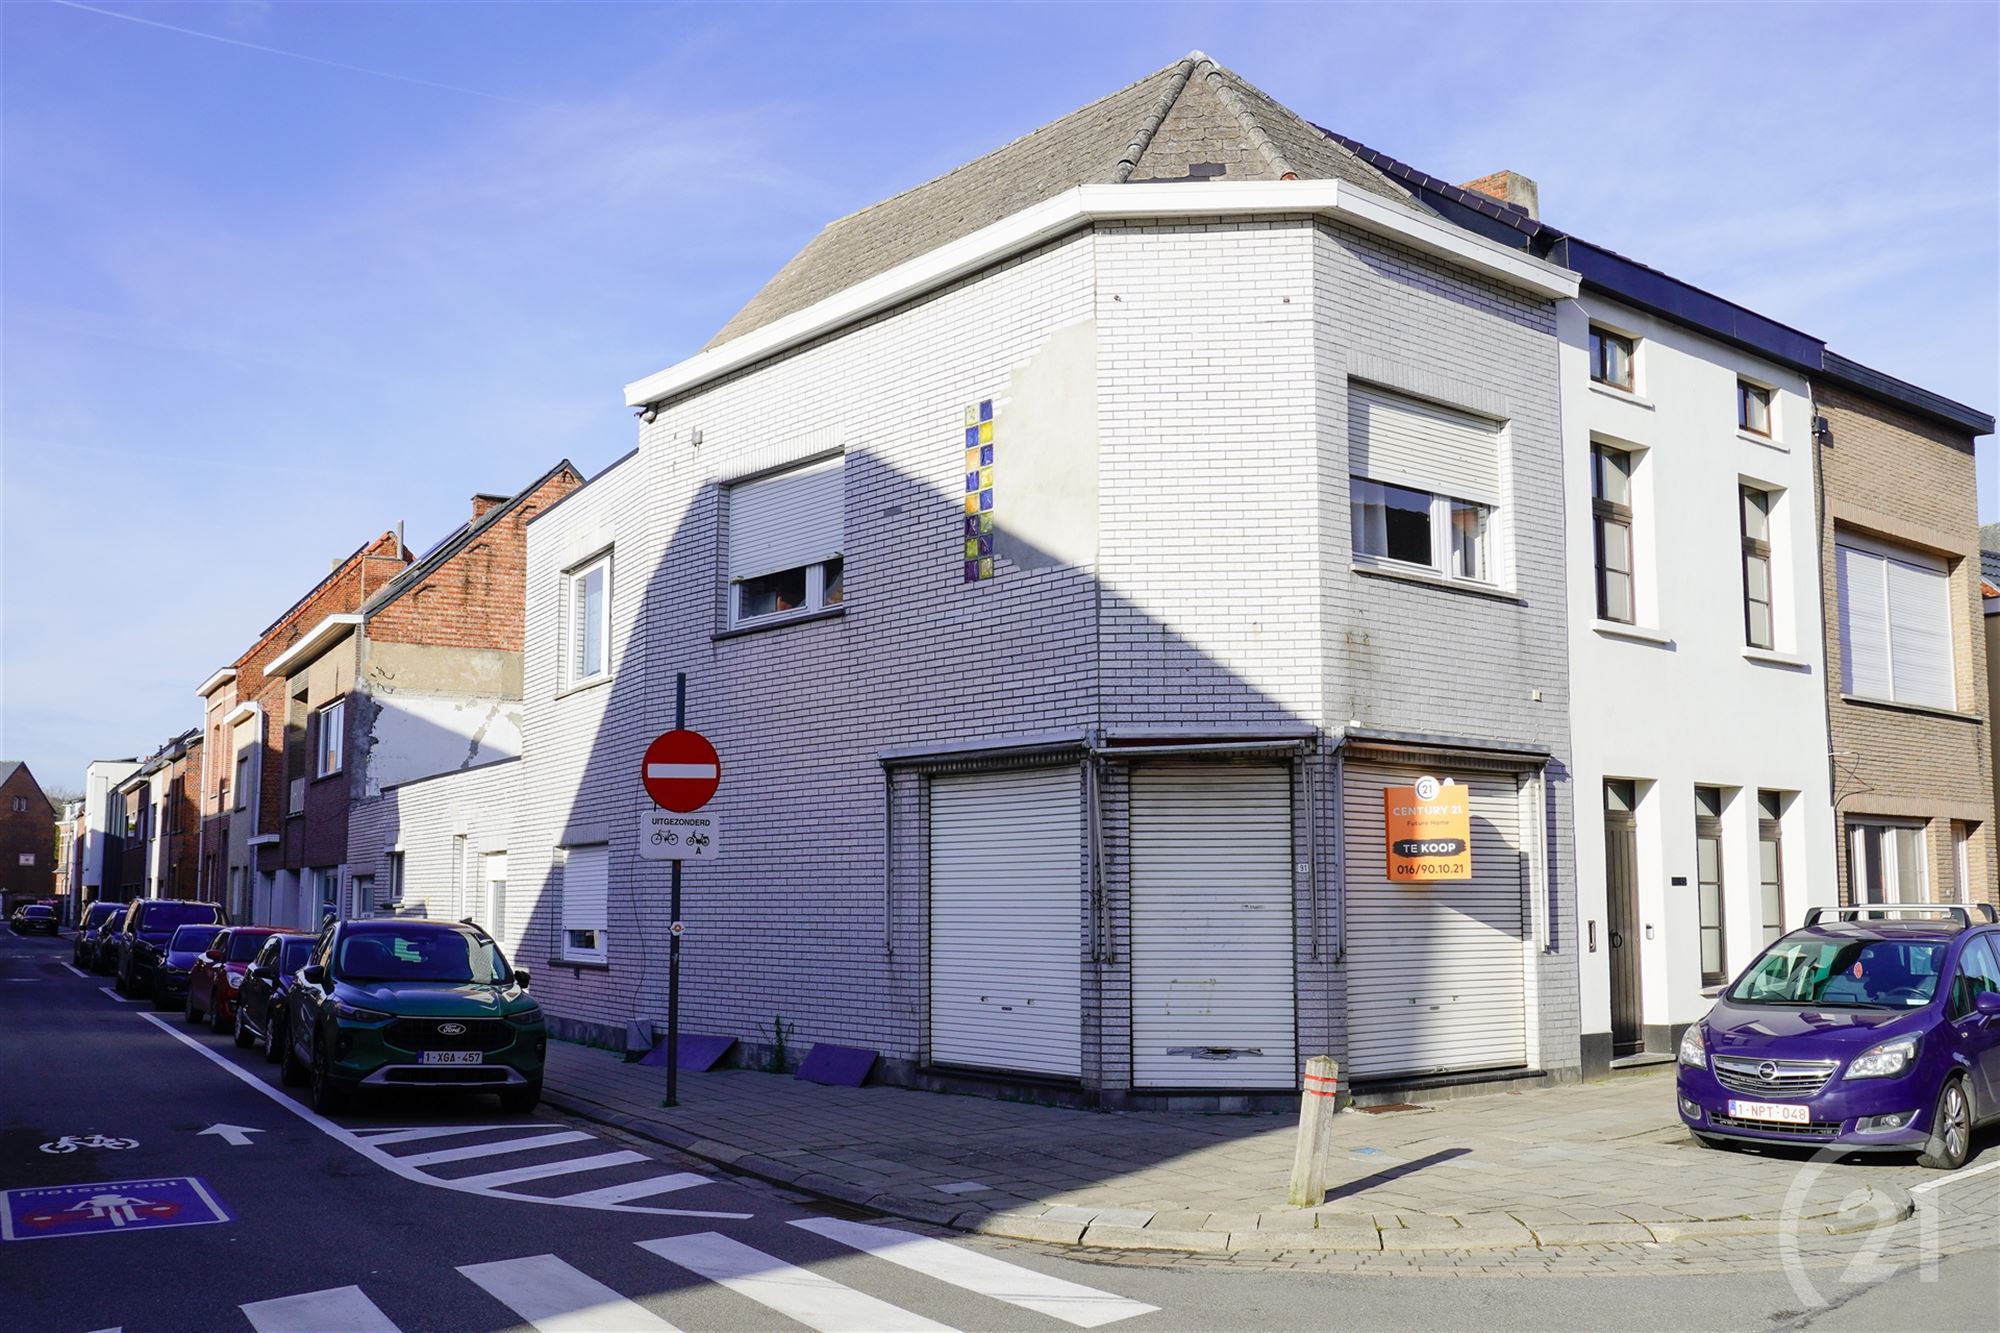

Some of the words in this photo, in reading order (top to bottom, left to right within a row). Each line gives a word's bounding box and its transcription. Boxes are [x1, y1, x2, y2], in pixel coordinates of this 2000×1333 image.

[1393, 805, 1449, 816] CENTURY
[1451, 804, 1463, 815] 21
[651, 817, 711, 827] UITGEZONDERD
[696, 847, 702, 855] A
[1403, 844, 1418, 853] TE
[1421, 842, 1456, 853] KOOP
[1397, 864, 1464, 874] 016/90.10.21
[443, 1024, 461, 1033] Ford
